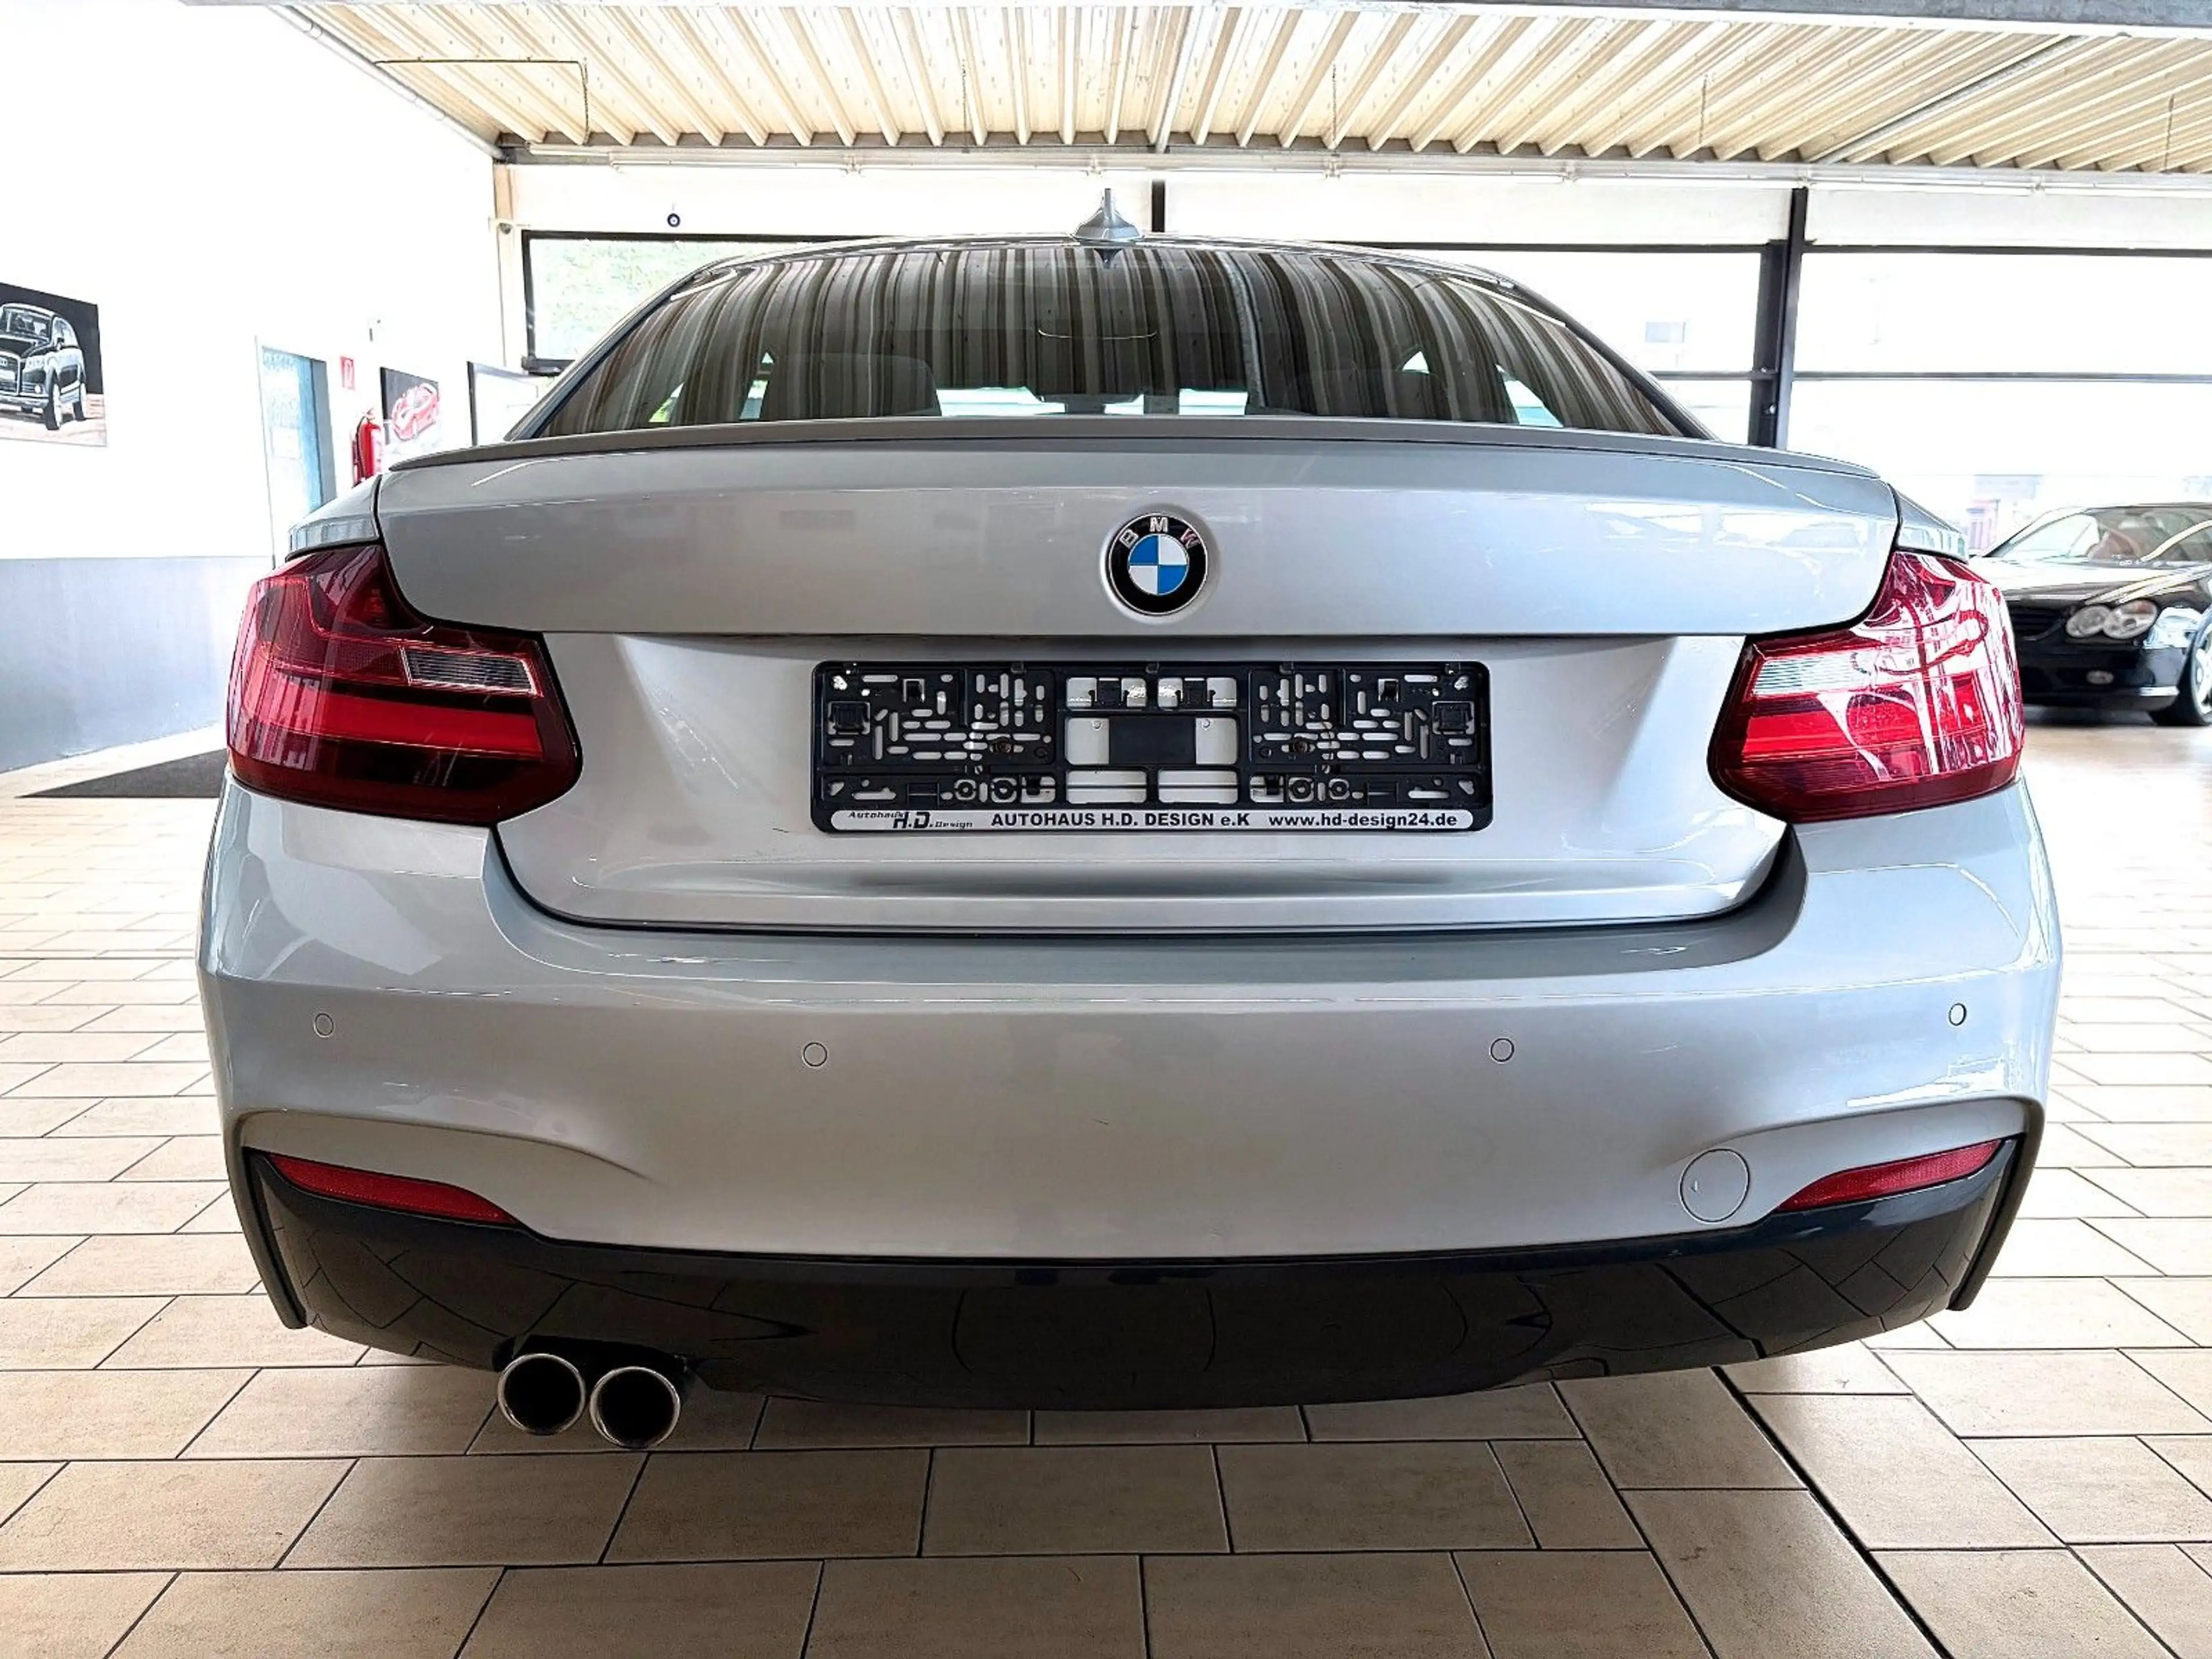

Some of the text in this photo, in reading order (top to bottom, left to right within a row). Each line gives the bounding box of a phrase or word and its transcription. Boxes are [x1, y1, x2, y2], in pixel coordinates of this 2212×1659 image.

[1119, 517, 1200, 549] BMW
[991, 813, 1457, 829] AUTOHAUS H.D. DESIGN e.K www.hd-design24.de
